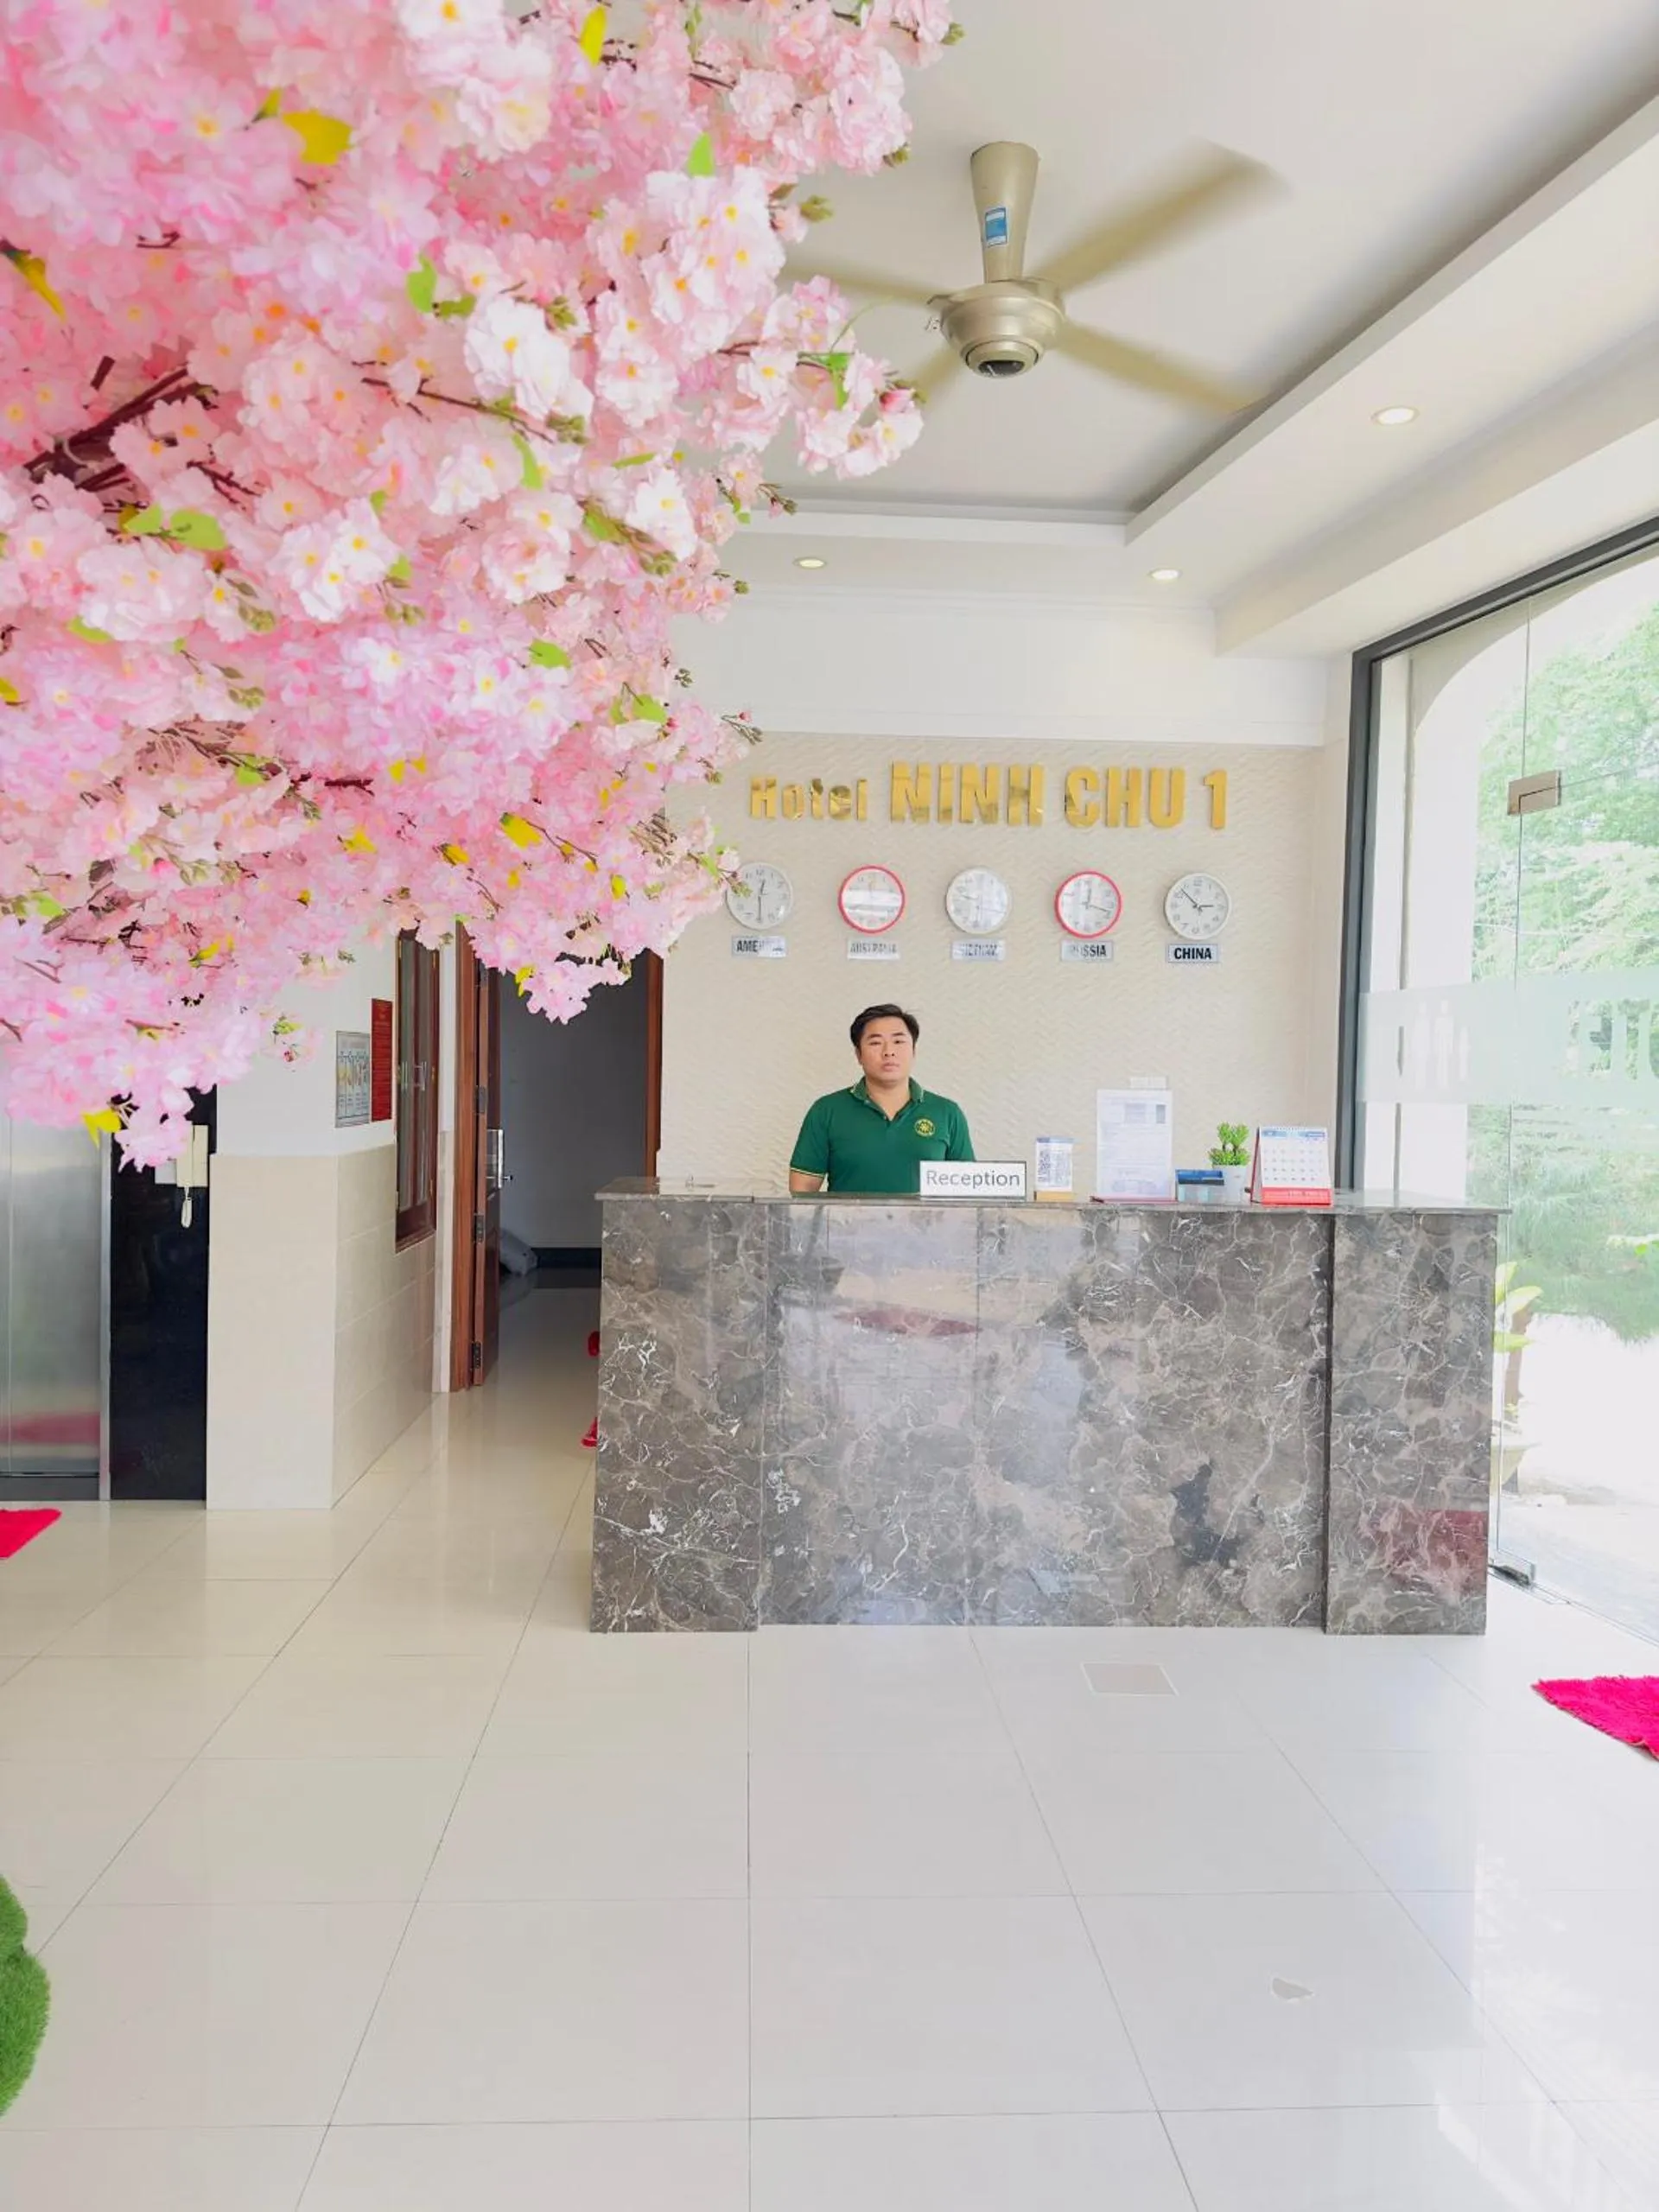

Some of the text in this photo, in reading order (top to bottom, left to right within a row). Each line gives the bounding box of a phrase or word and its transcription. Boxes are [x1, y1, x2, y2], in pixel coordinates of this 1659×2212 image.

[750, 760, 1228, 830] Hotel NINH CHU 1
[1173, 947, 1212, 960] CHINA
[926, 1170, 1020, 1189] Reception
